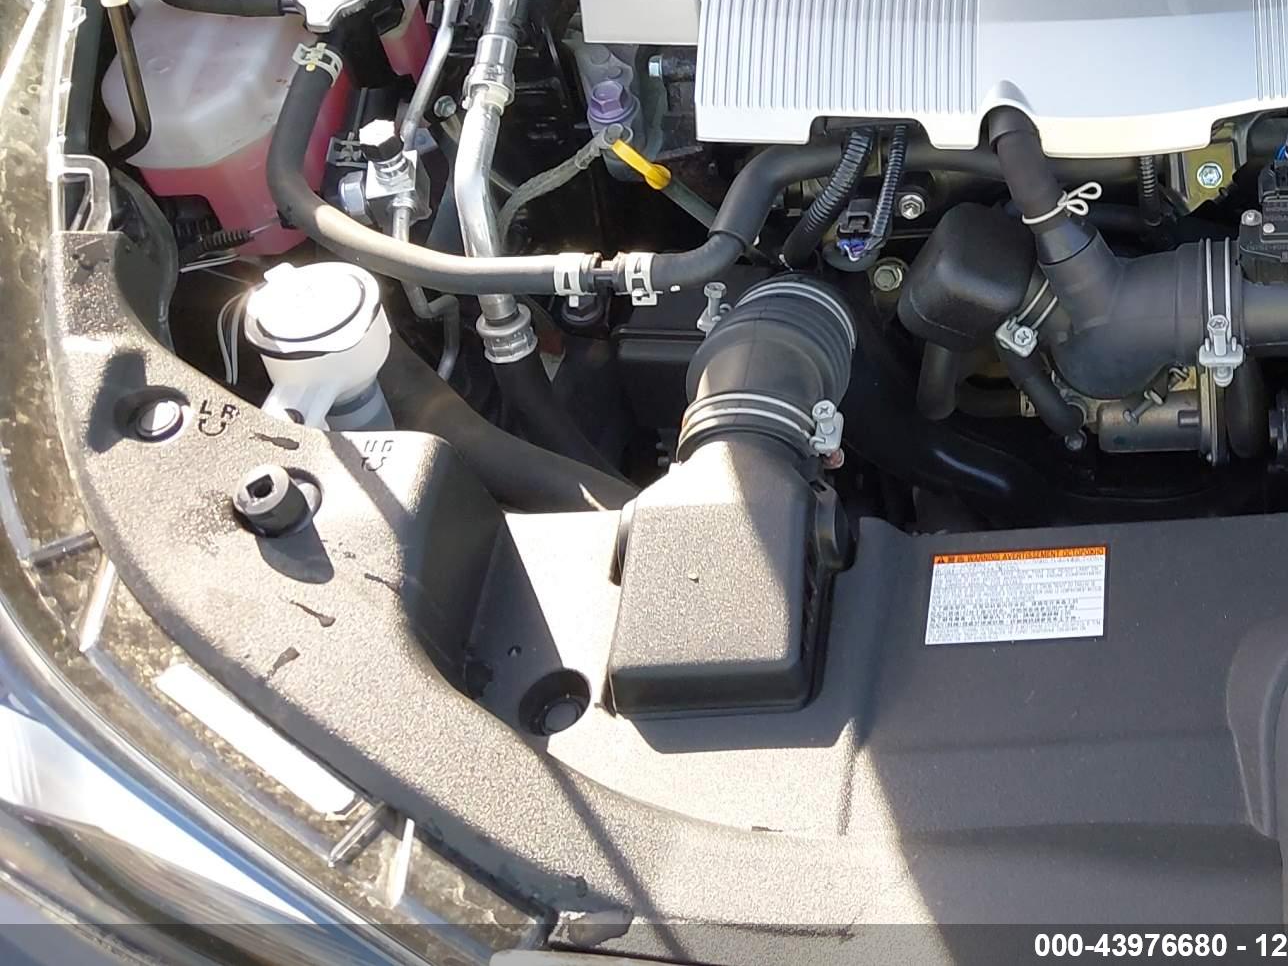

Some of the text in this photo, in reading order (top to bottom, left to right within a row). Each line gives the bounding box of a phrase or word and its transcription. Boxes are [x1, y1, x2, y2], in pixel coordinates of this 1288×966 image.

[200, 400, 235, 420] L R
[967, 552, 999, 563] WARNING
[1002, 548, 1058, 562] AVERTISSEMENT
